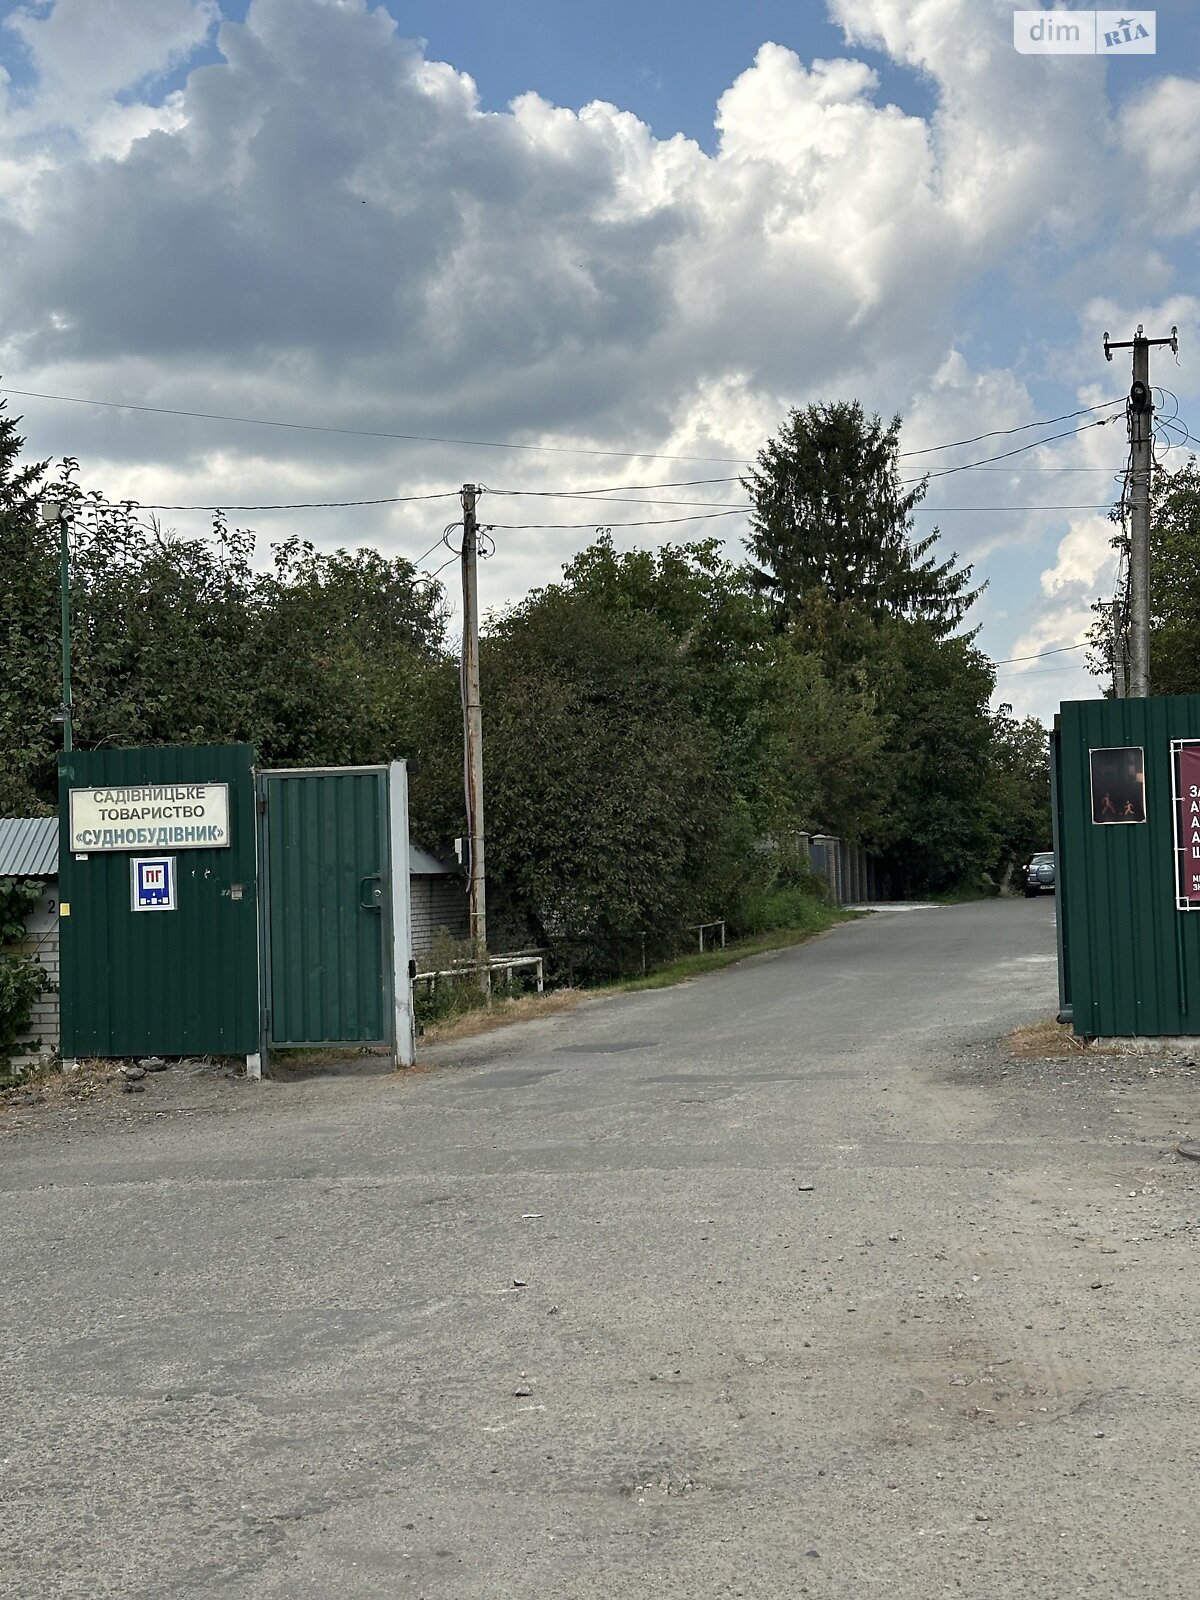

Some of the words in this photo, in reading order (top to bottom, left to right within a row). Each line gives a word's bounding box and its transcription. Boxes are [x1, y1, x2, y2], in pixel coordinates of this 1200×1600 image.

[93, 786, 206, 804] САДІВНИЦЬКЕ
[1189, 785, 1200, 797] З
[99, 805, 205, 821] ТОВАРИСТВО
[1190, 800, 1200, 812] А
[75, 825, 224, 847] «СУДНОБУДІВНИК»
[145, 870, 162, 883] ПГ
